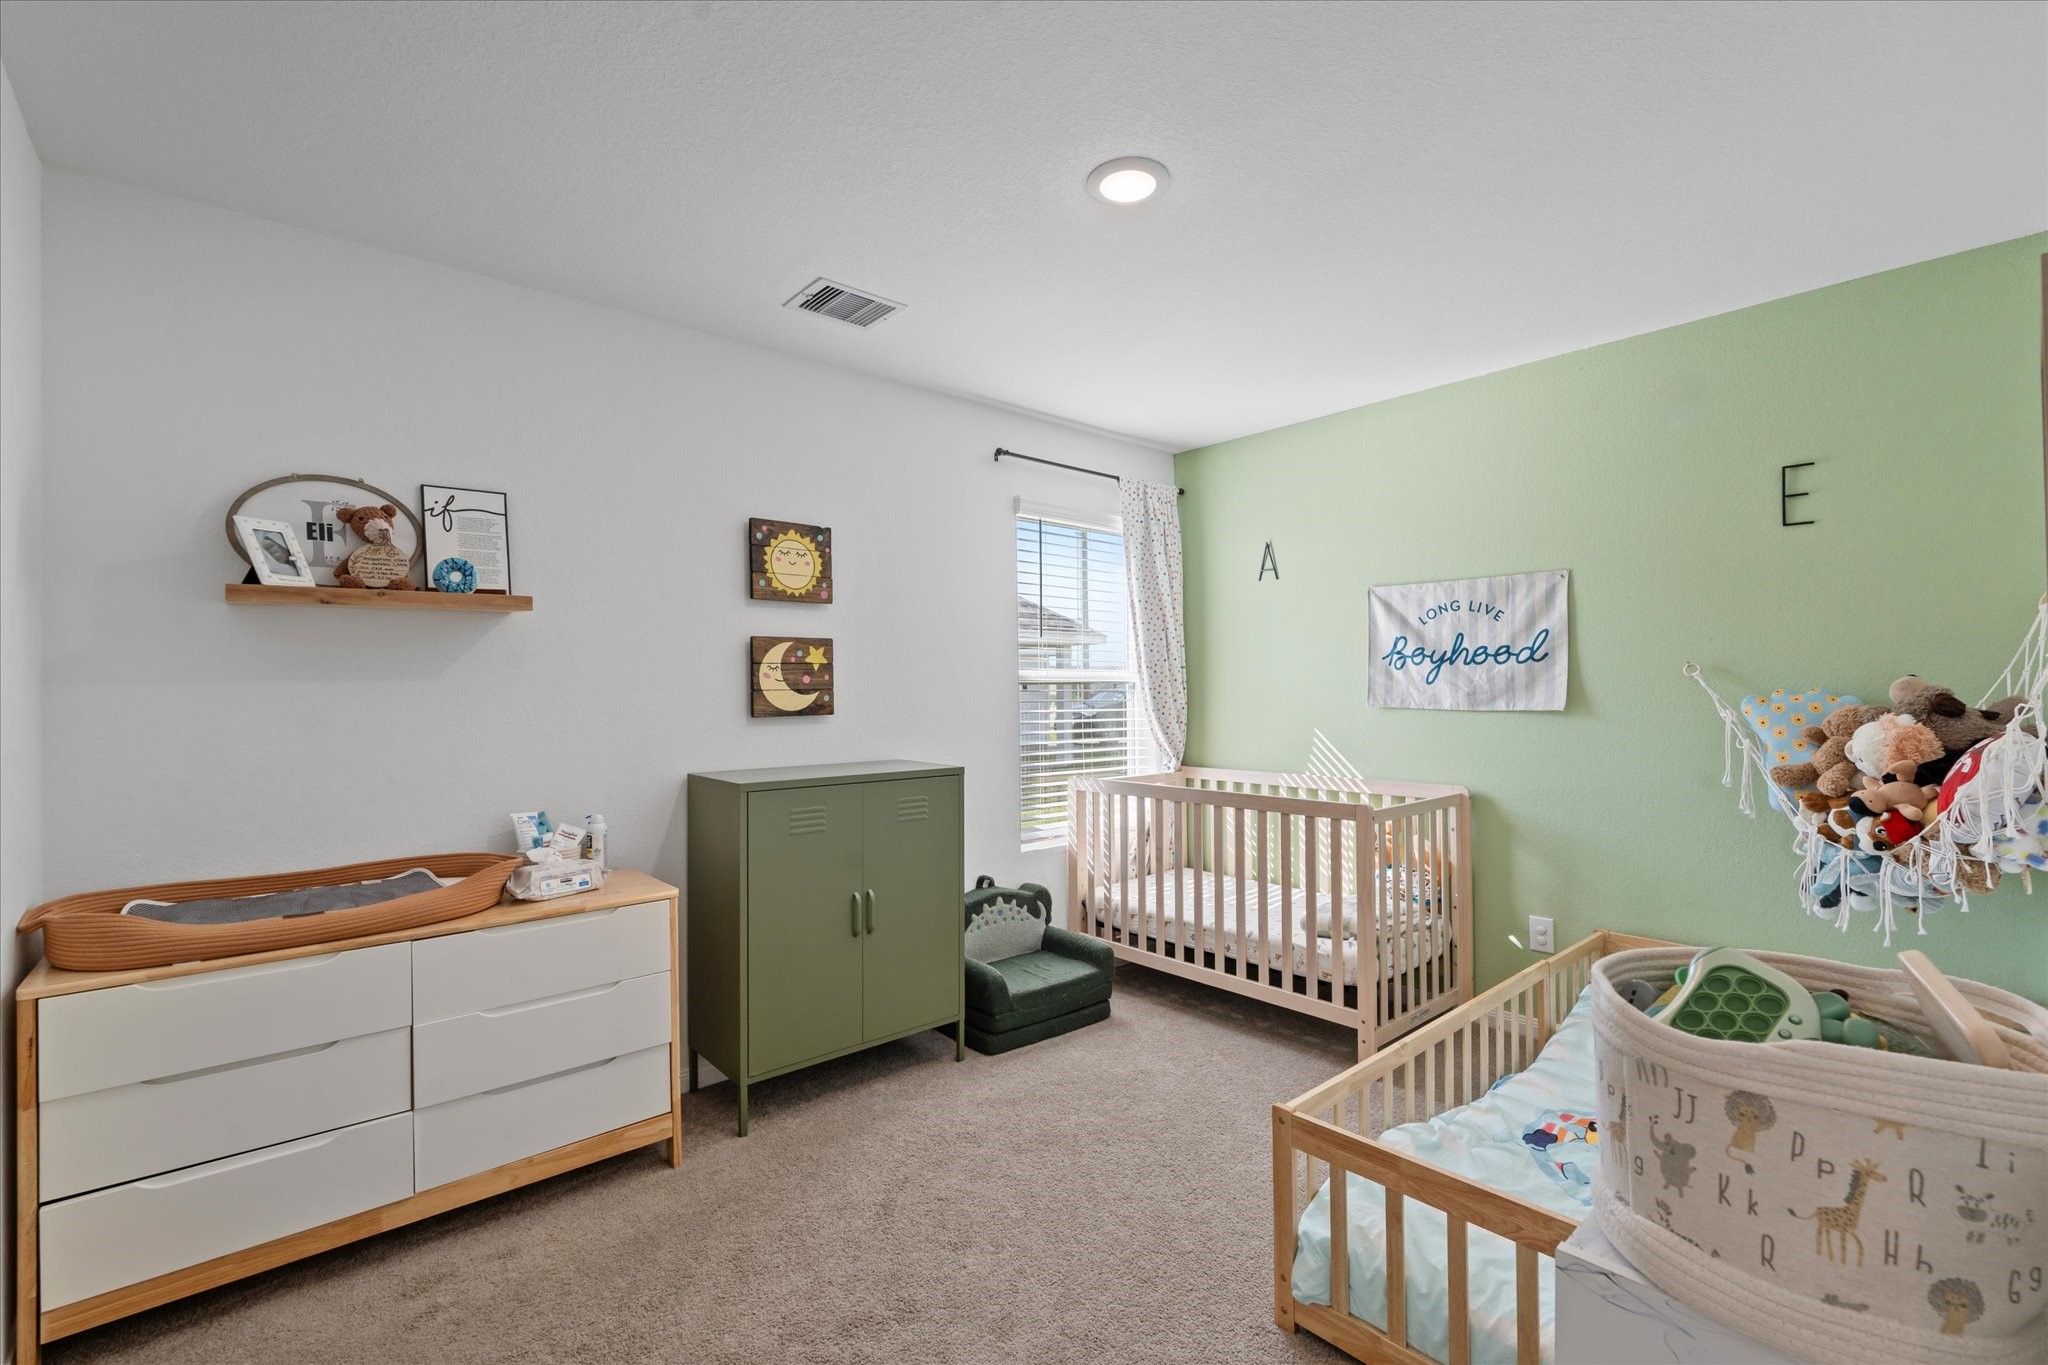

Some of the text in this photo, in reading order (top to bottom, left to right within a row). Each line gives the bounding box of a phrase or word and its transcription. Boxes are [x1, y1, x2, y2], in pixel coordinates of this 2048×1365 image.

[1782, 462, 1815, 527] E
[306, 522, 334, 542] Eli
[1259, 540, 1279, 581] A
[1418, 600, 1505, 626] LONG LIVE
[1382, 628, 1549, 685] Boyhood
[1718, 1173, 1732, 1207] K
[1909, 1168, 1927, 1208] R
[1761, 1234, 1776, 1272] R
[1884, 1229, 1899, 1266] H
